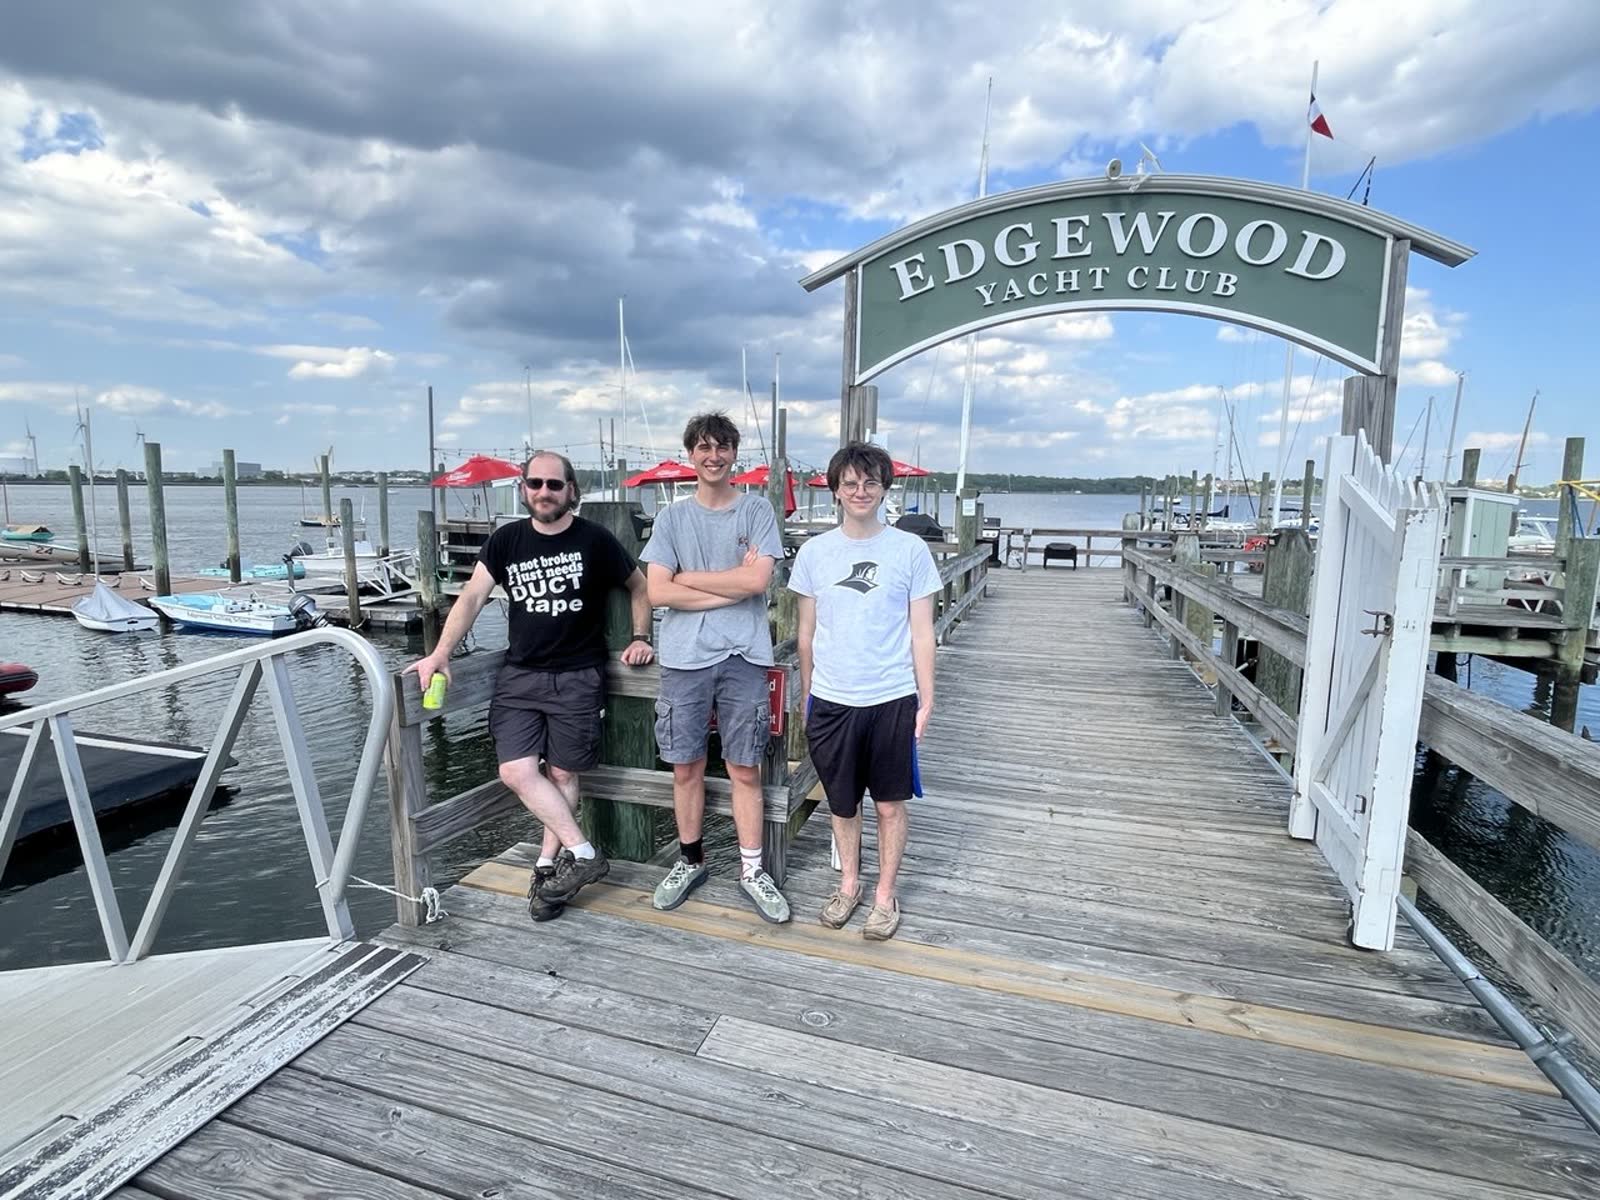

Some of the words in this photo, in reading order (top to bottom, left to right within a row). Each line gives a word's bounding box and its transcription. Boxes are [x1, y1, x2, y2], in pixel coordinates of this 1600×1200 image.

[889, 211, 1347, 302] EDGEWOOD
[975, 266, 1110, 307] YACHT
[1127, 265, 1239, 297] CLUB
[515, 569, 543, 586] just
[545, 561, 583, 578] needs
[519, 558, 540, 572] not
[539, 551, 582, 568] broken
[511, 572, 583, 602] DUCT
[525, 597, 583, 617] tape
